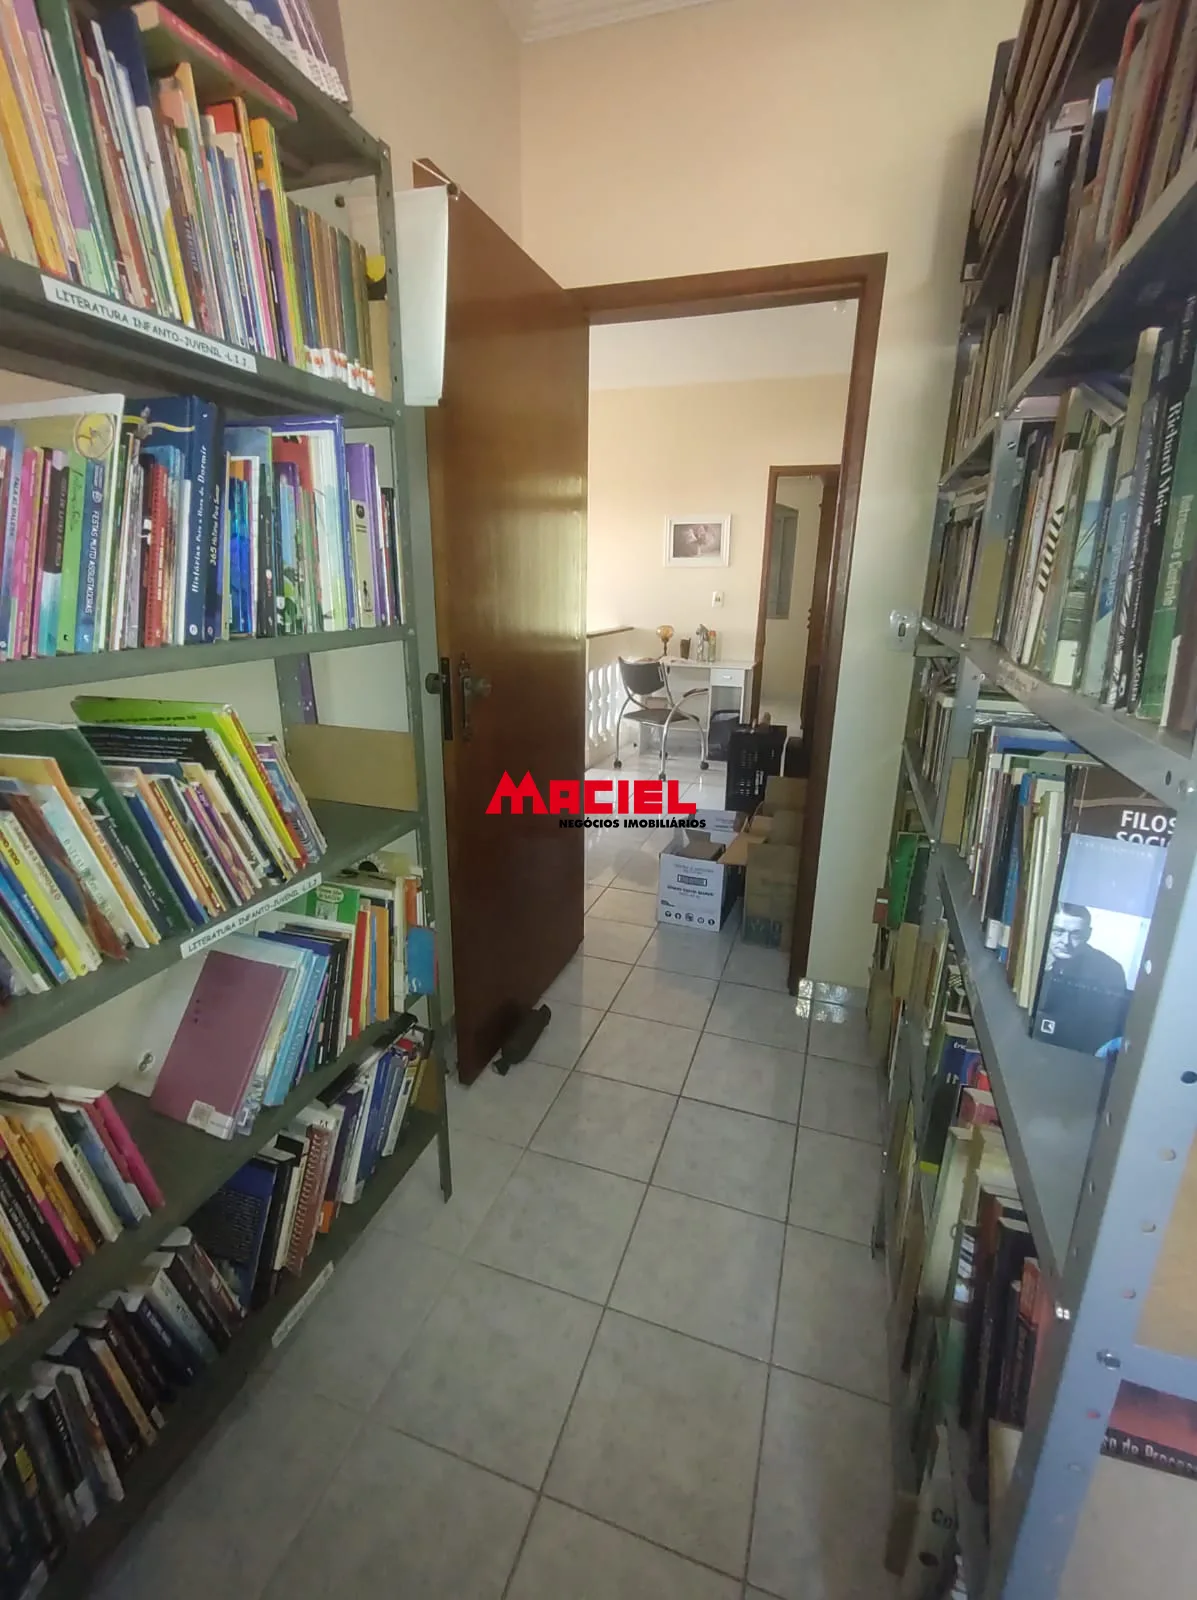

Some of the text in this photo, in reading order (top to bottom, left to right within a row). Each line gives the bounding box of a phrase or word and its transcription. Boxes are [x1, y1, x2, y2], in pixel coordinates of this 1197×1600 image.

[55, 286, 129, 325] LITERATURA
[1162, 400, 1183, 471] Richard
[209, 546, 217, 567] 365
[1131, 652, 1144, 701] TASCHEN
[188, 922, 236, 952] LITERATURA
